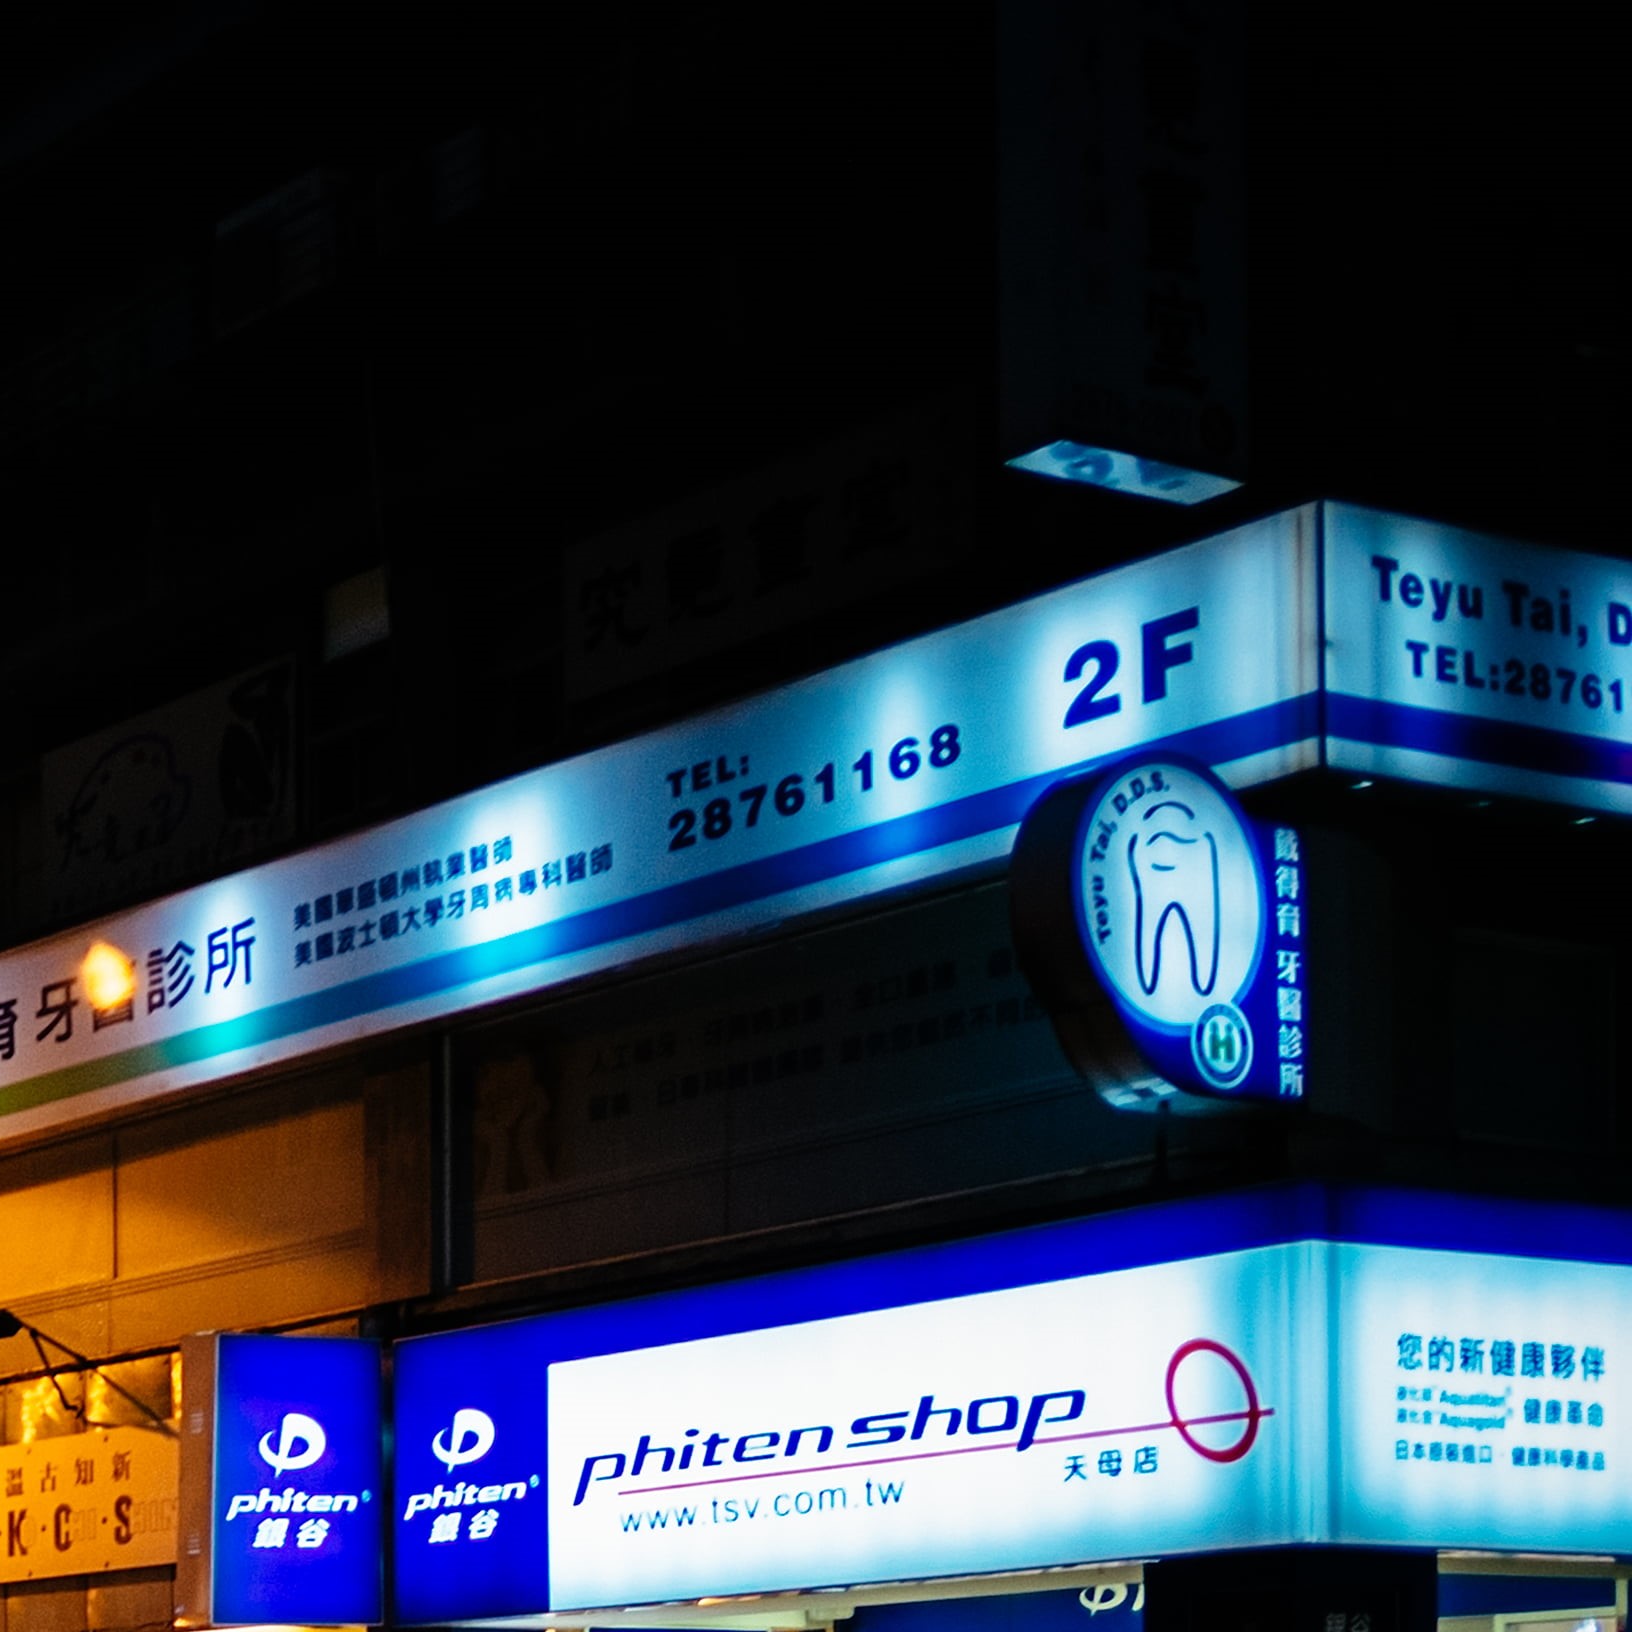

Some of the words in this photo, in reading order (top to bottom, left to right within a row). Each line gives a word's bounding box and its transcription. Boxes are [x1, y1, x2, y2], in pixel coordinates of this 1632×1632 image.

[1371, 554, 1483, 622] Teyu
[1502, 579, 1588, 648] Tai,
[1063, 605, 1199, 729] 2F
[666, 753, 750, 799] TEL:
[667, 723, 961, 852] 28761168
[1397, 1332, 1605, 1383] 您的新健康夥伴
[573, 1424, 835, 1506] phiten
[846, 1388, 1086, 1452] shop
[1063, 1445, 1160, 1483] 天母店
[225, 1487, 359, 1521] phiten
[403, 1481, 527, 1521] phiten
[620, 1476, 905, 1534] www.tsv.com.tw
